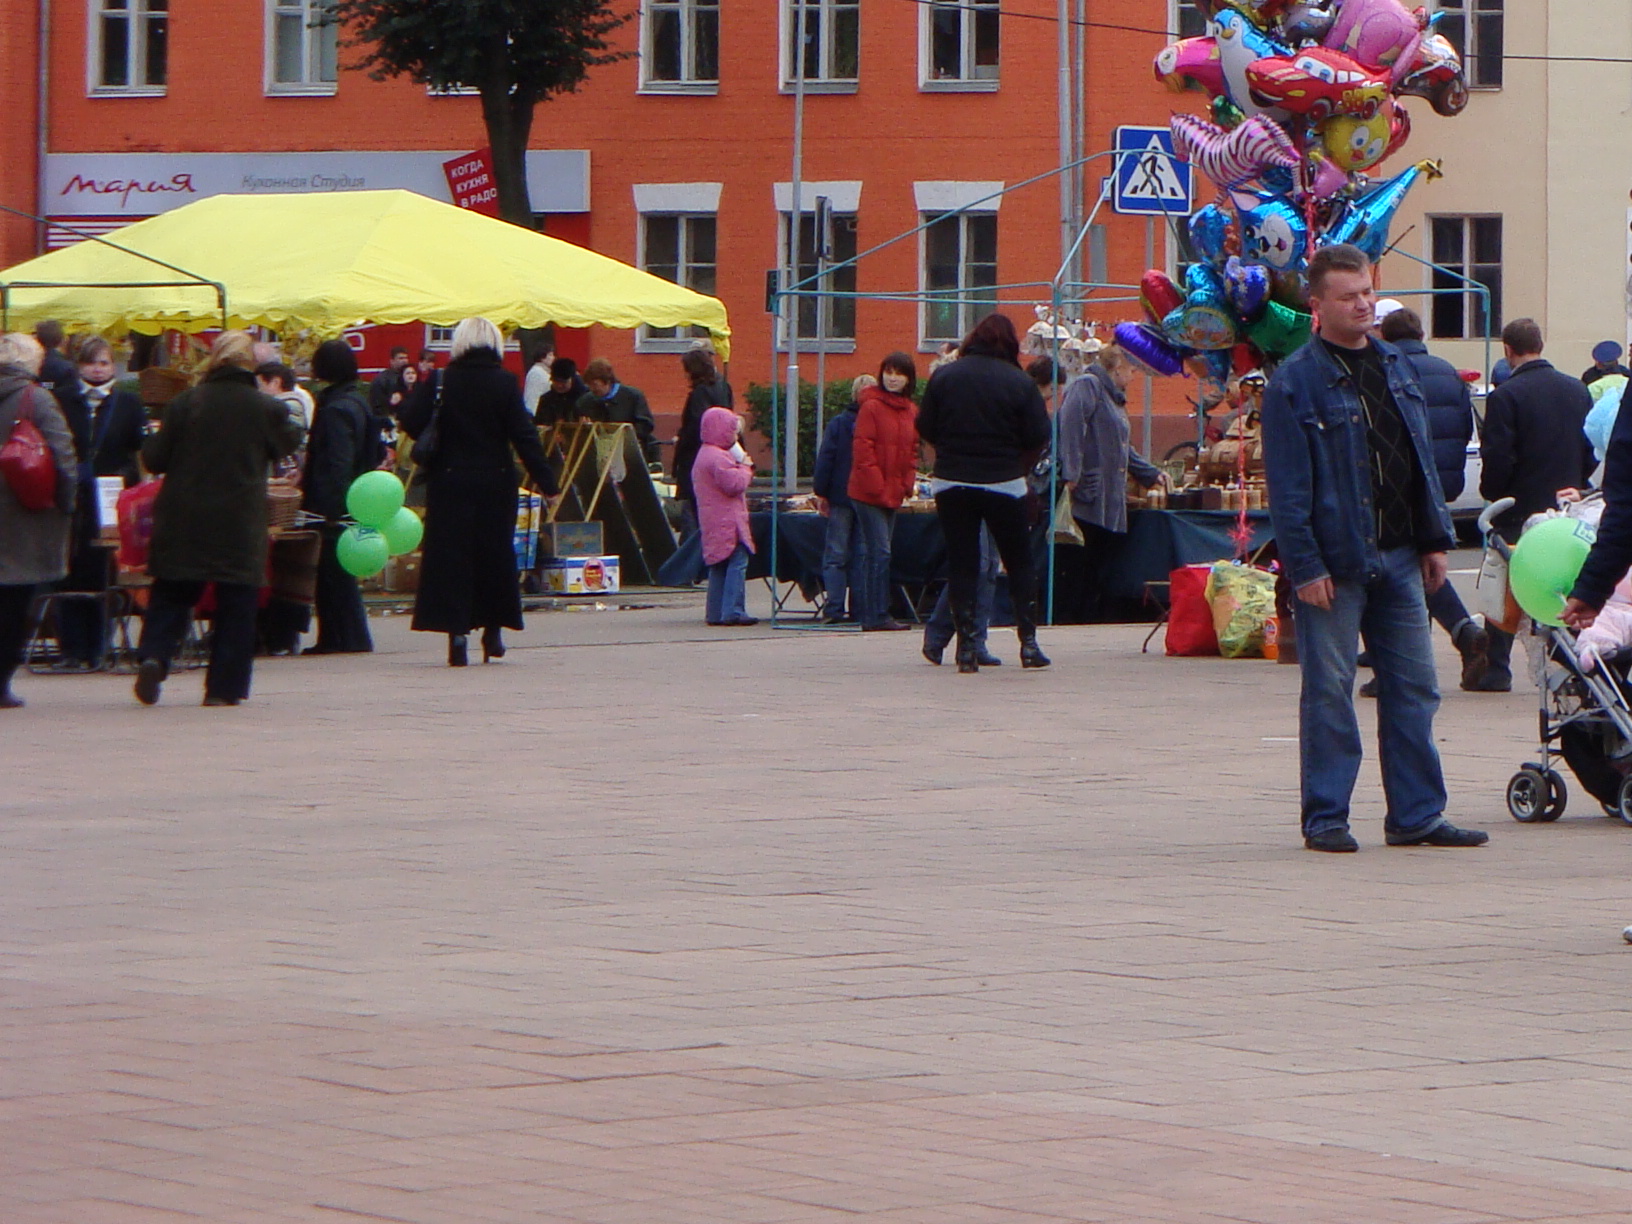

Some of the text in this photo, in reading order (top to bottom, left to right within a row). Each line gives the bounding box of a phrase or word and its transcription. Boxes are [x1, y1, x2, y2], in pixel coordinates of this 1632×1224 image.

[450, 159, 484, 178] КОГДА
[456, 174, 489, 193] КУХНЯ
[461, 188, 497, 207] В РАДО
